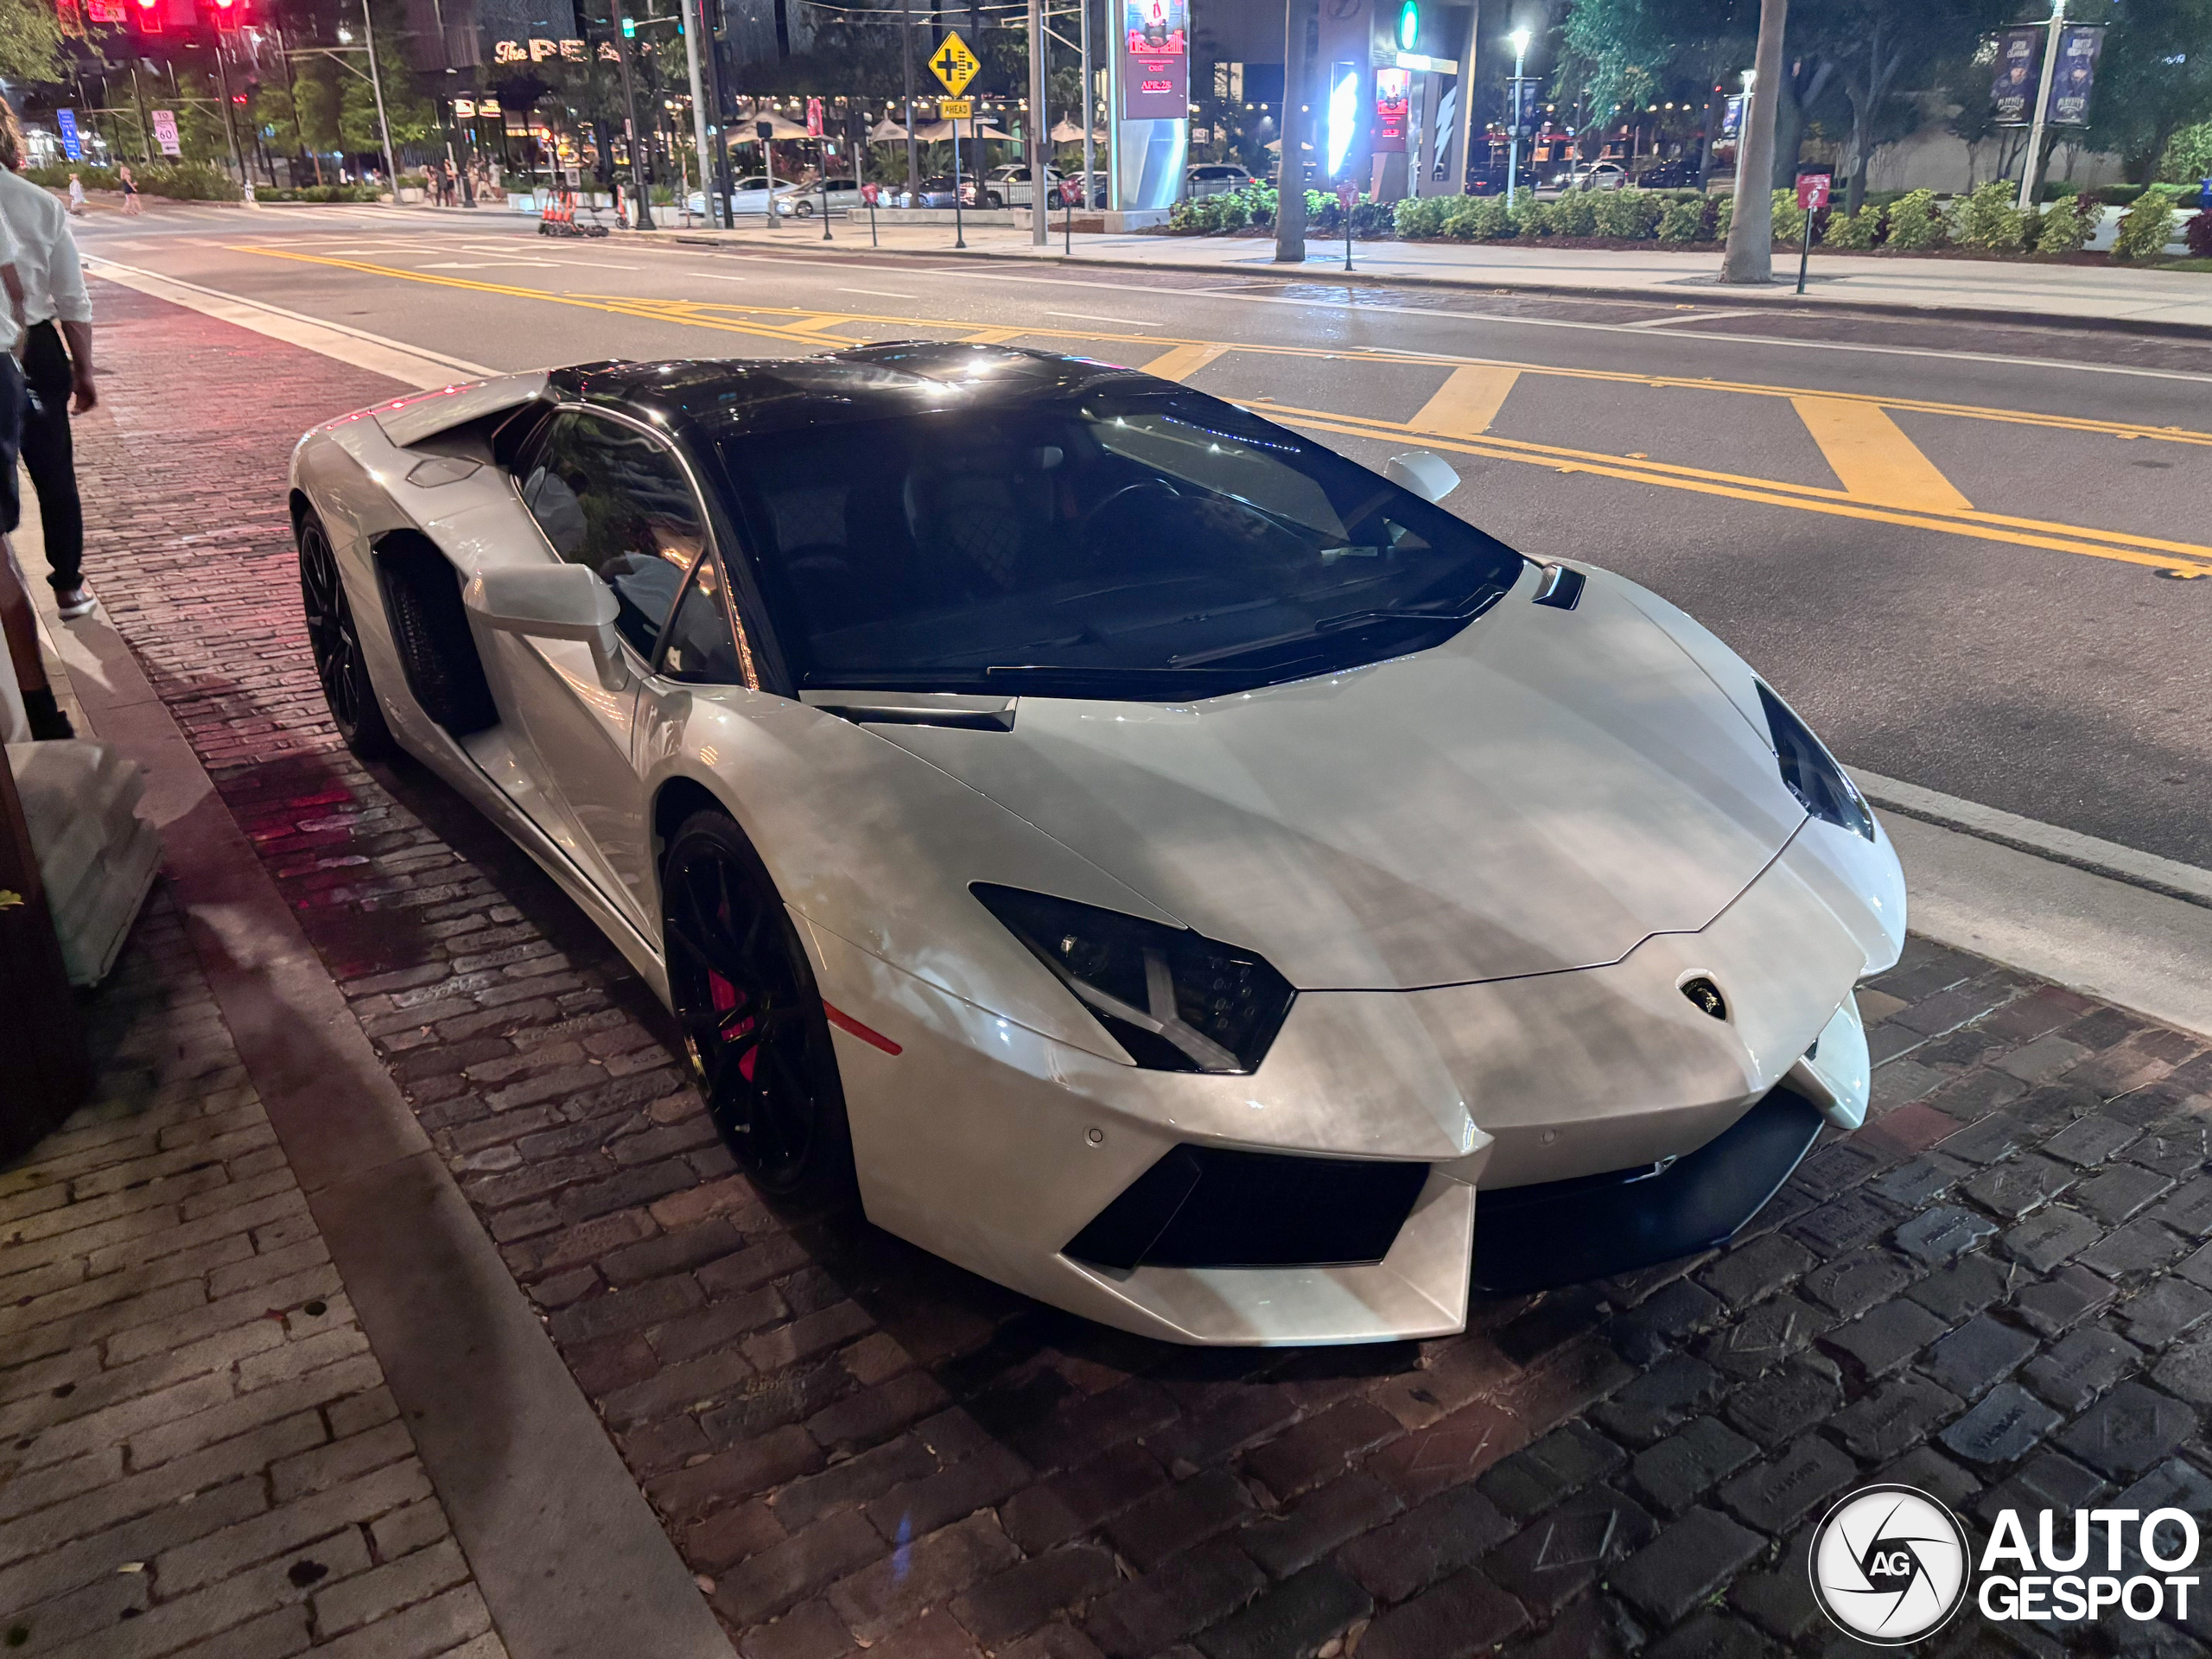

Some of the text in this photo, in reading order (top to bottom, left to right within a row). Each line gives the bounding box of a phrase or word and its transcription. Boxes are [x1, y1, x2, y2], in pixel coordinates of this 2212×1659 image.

[494, 41, 528, 64] The
[945, 105, 968, 114] AHEAD
[160, 130, 172, 140] 60
